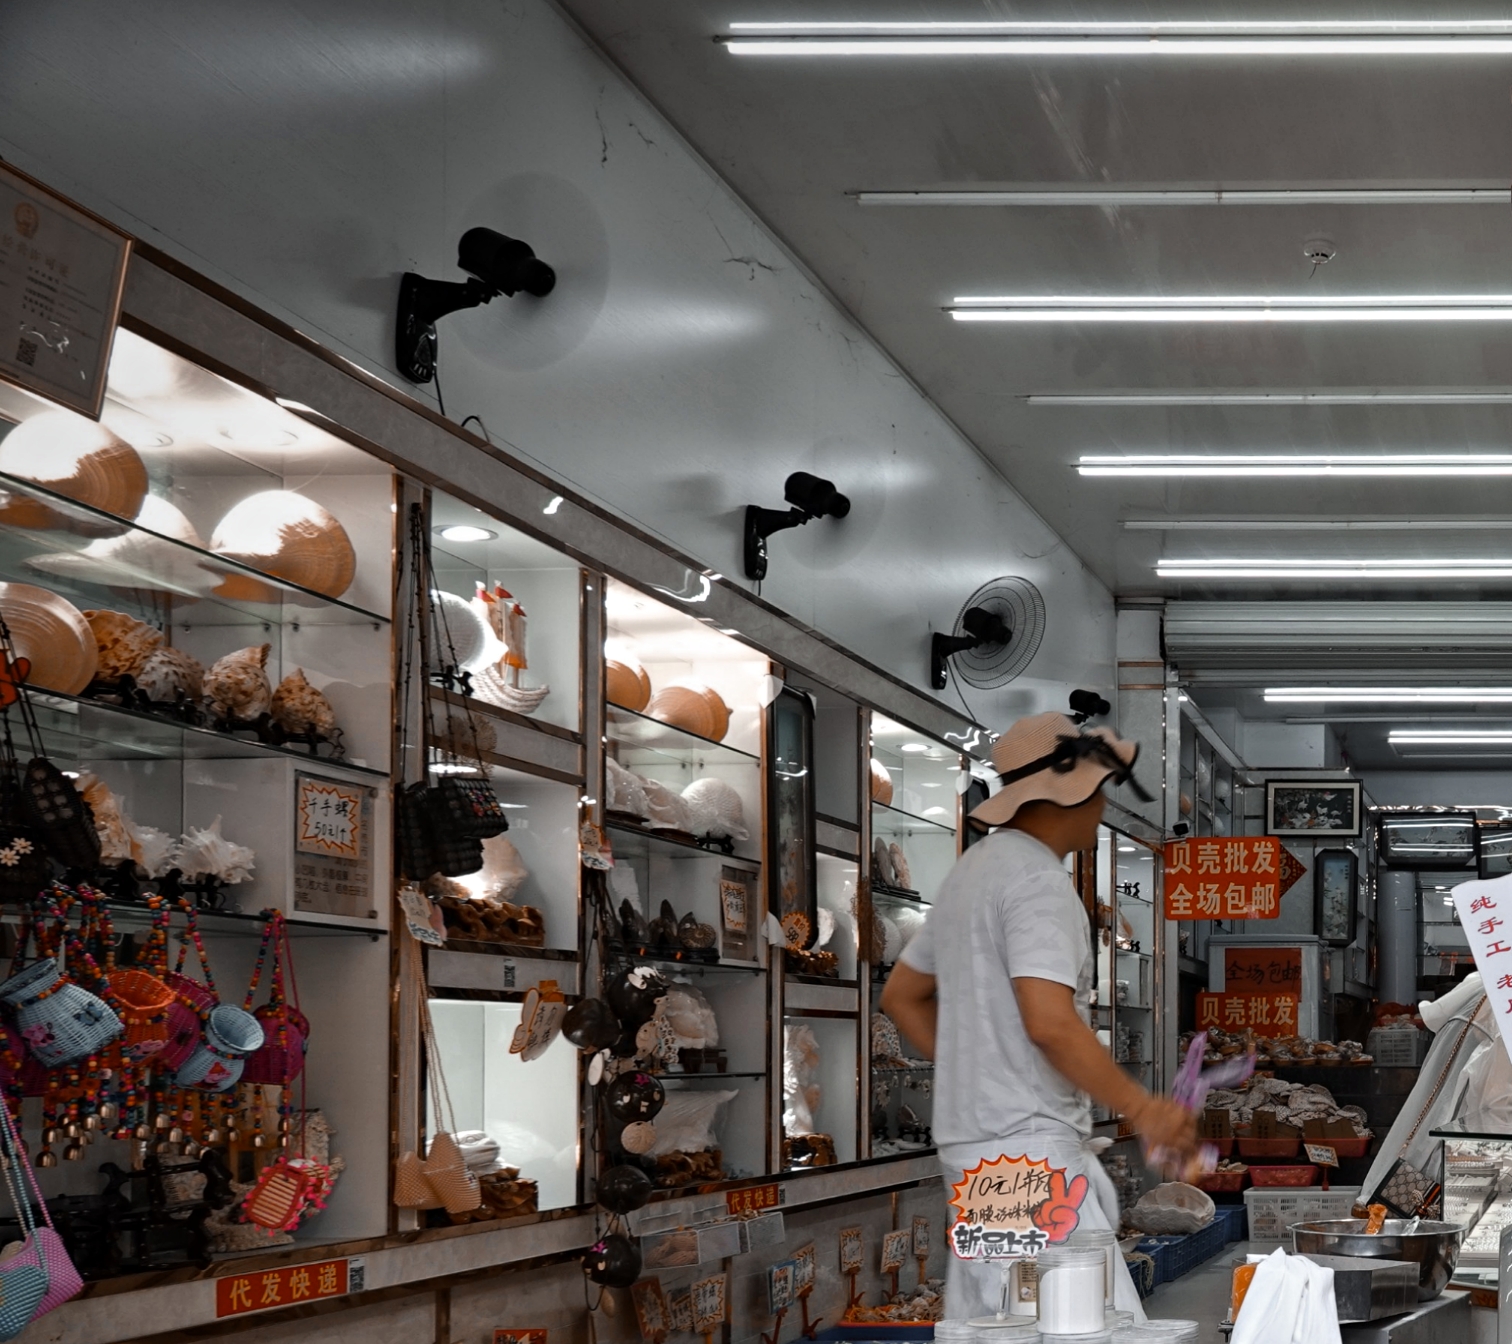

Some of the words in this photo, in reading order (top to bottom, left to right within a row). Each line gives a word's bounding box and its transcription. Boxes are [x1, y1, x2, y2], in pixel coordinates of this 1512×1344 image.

[1171, 841, 1275, 875] 贝壳批发
[1169, 882, 1275, 916] 全场包邮
[1470, 896, 1511, 957] 纯手工
[1226, 959, 1301, 992] 全场包邮
[1201, 997, 1294, 1026] 贝壳批发
[955, 1226, 1046, 1255] 新品上市
[230, 1263, 339, 1309] 代发快递
